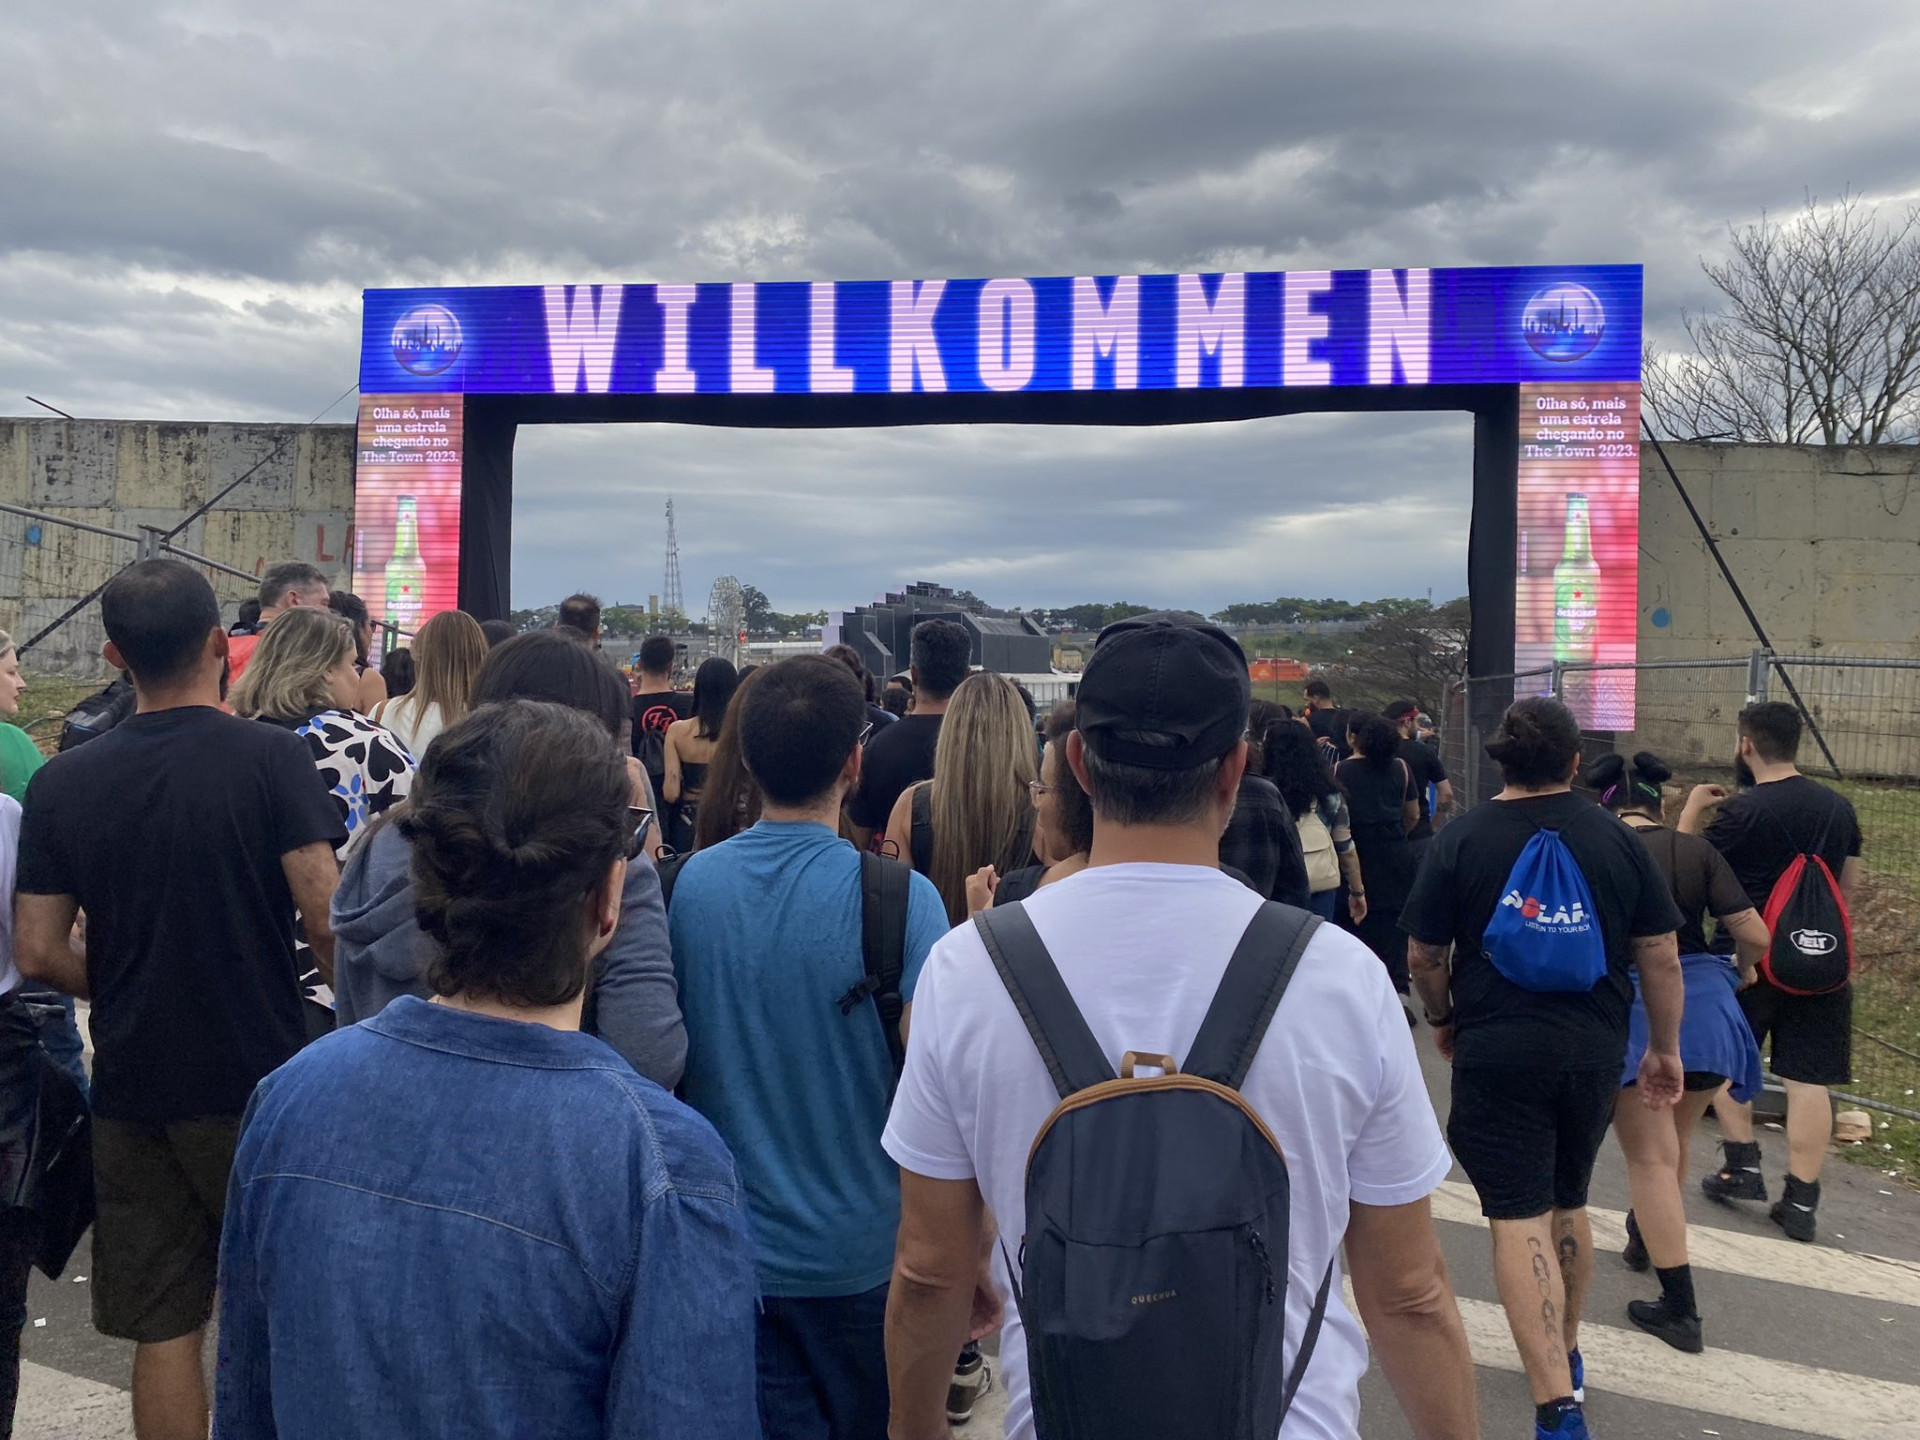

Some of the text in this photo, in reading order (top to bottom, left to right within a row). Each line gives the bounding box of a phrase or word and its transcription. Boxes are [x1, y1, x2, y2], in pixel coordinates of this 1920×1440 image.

[542, 267, 1431, 394] WILLKOMMEN
[1536, 397, 1626, 411] Olha só, mais
[373, 407, 450, 420] Olha só, mais
[1539, 412, 1622, 425] uma estrela
[375, 421, 447, 433] uma estrela
[1536, 427, 1625, 443] chegando no
[372, 435, 449, 449] chegando no
[362, 451, 459, 462] The Town 2023.
[1524, 444, 1637, 457] The Town 2023.
[1558, 926, 1579, 934] YOUR
[1131, 1290, 1177, 1304] QUECHUA
